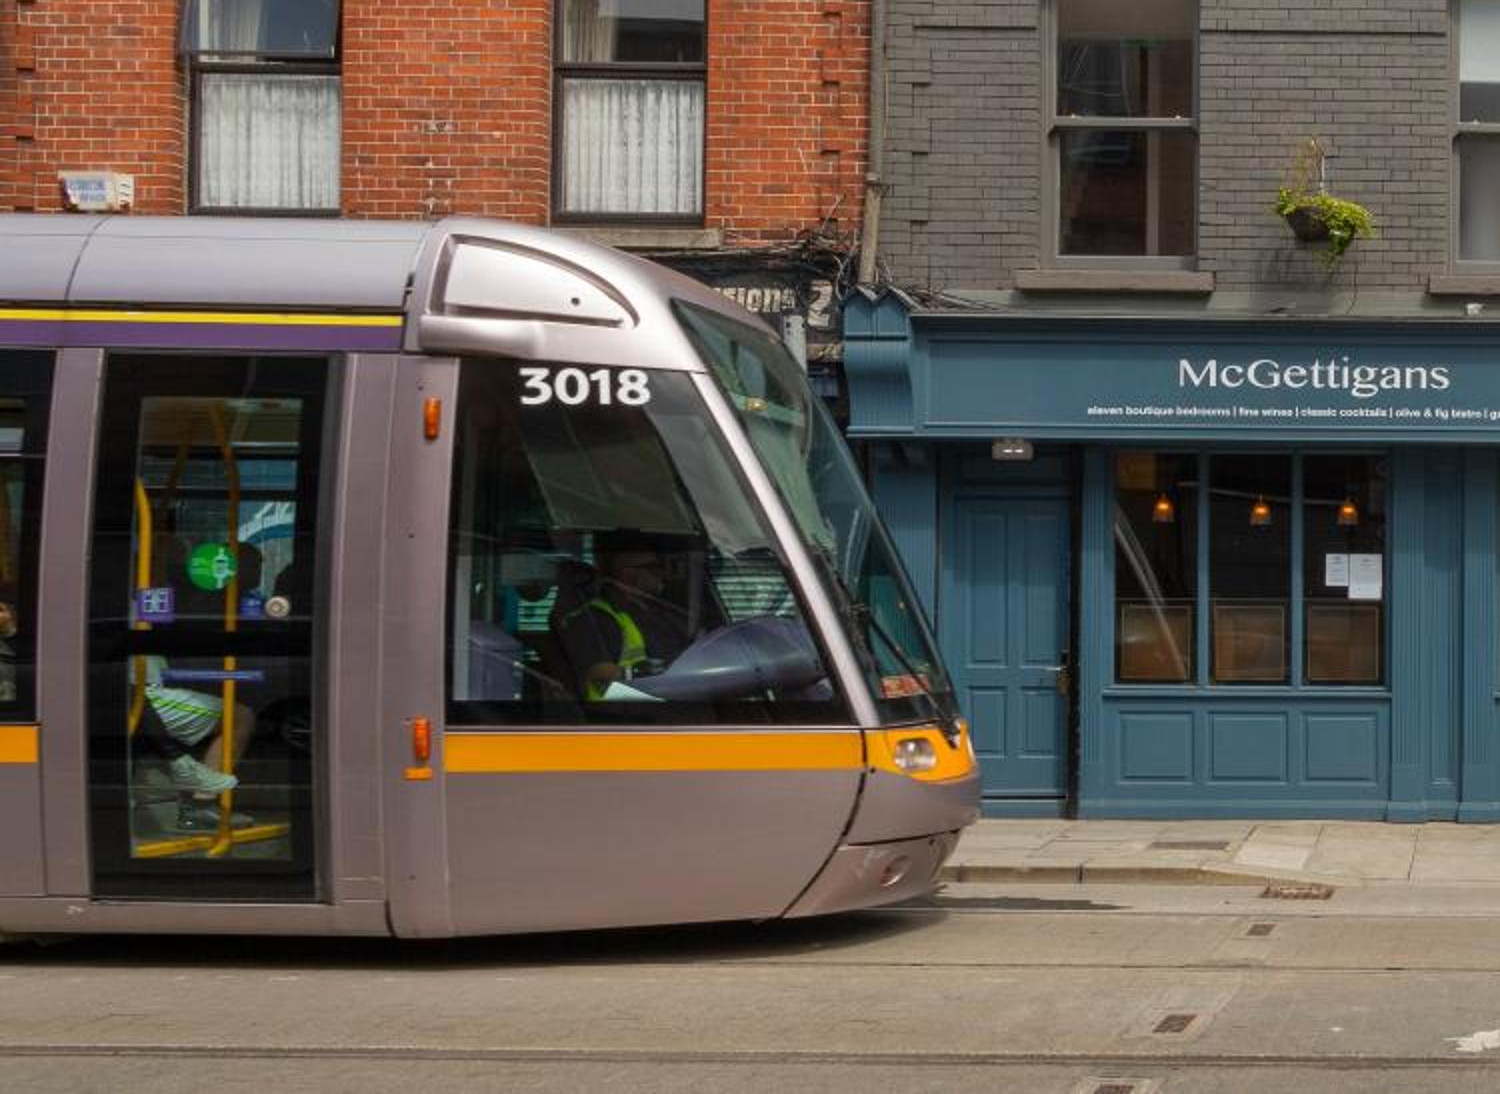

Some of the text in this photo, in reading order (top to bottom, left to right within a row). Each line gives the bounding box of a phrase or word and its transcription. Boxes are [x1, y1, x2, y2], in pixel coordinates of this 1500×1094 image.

[518, 367, 652, 406] 3018
[1178, 356, 1451, 398] McGettigans
[1088, 406, 1123, 415] eleven
[1126, 406, 1174, 417] boutique
[1176, 406, 1231, 416] bedrooms
[1239, 406, 1259, 416] fine
[1261, 408, 1293, 417] wines
[1339, 407, 1387, 417] cocktails
[1395, 407, 1420, 417] olive
[1423, 408, 1433, 418] &
[1435, 407, 1449, 420] fig
